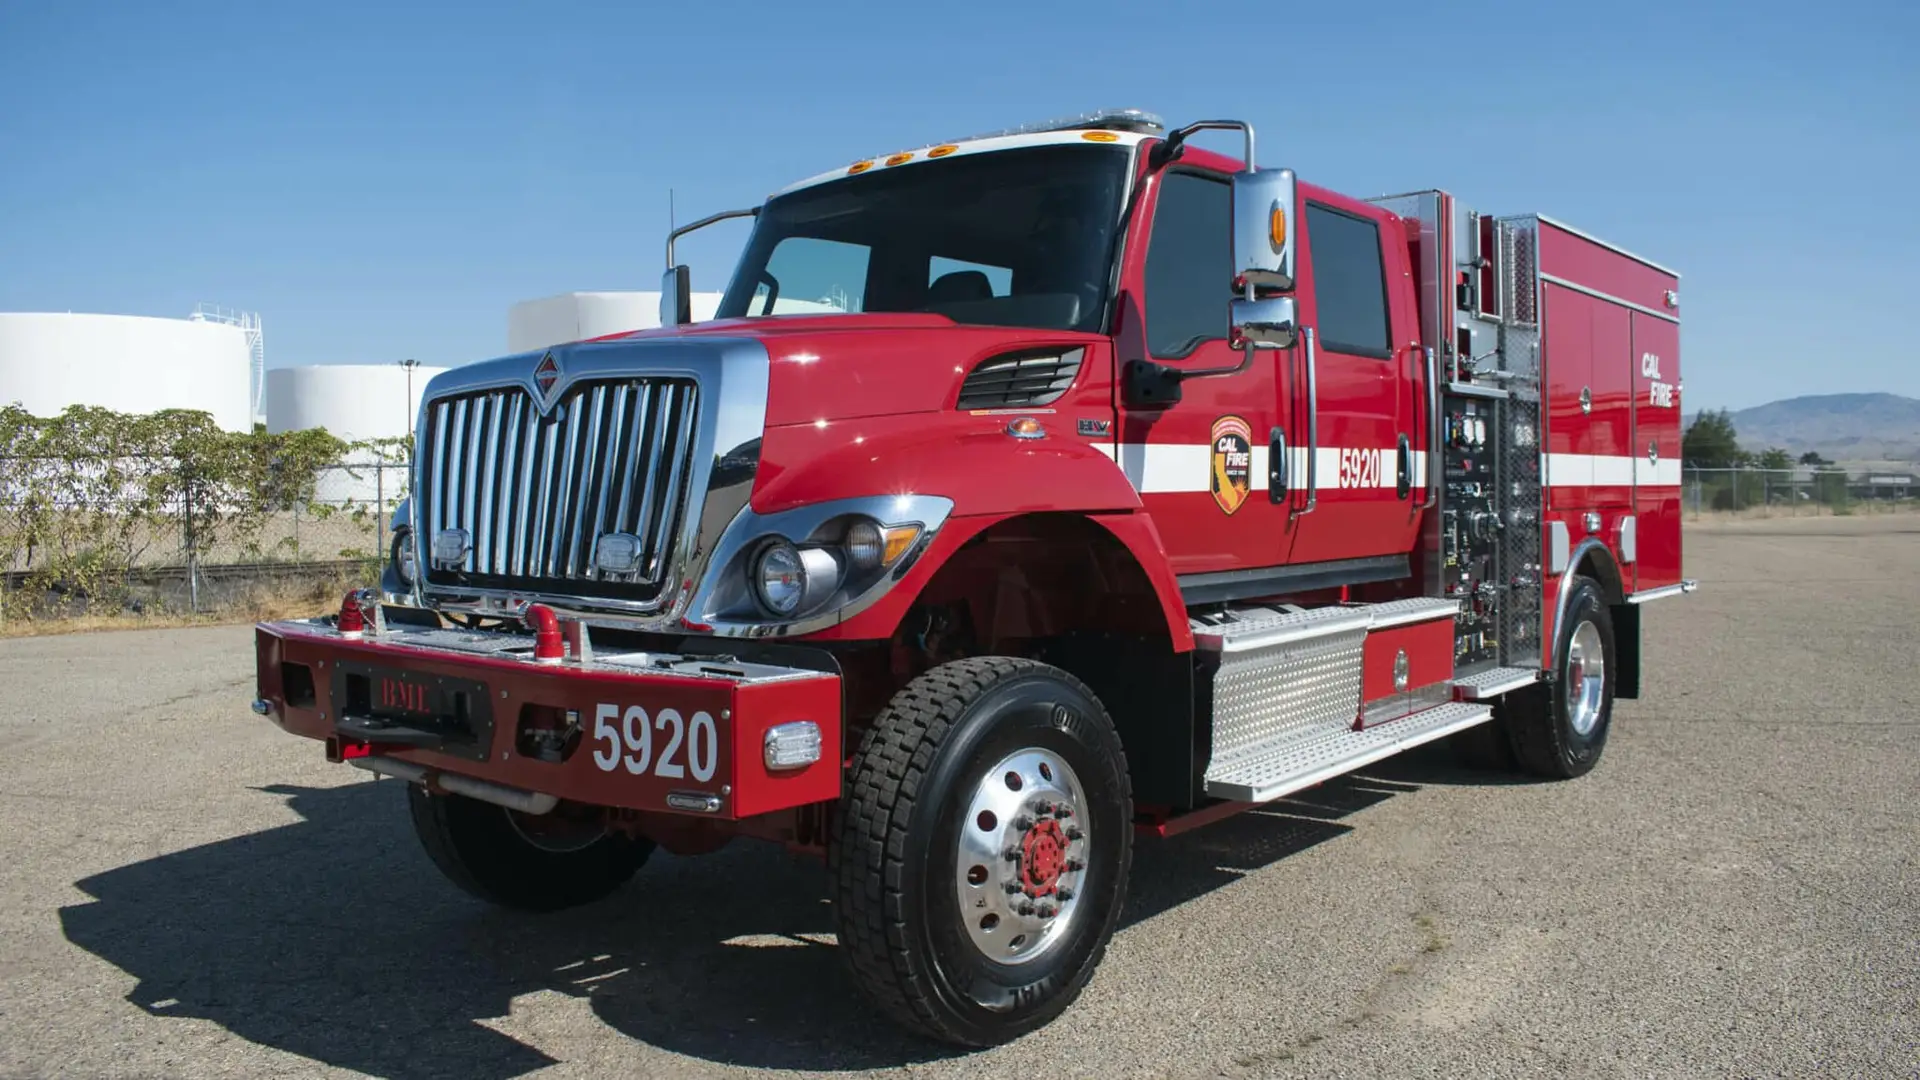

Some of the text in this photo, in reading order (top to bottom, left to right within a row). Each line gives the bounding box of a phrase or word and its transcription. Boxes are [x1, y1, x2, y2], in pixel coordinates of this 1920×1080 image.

[1642, 352, 1661, 379] CAL
[1650, 381, 1673, 408] FIRE
[1218, 437, 1238, 452] CAL
[1226, 452, 1249, 467] FIRE
[1341, 447, 1380, 489] 5920
[592, 702, 718, 783] 5920
